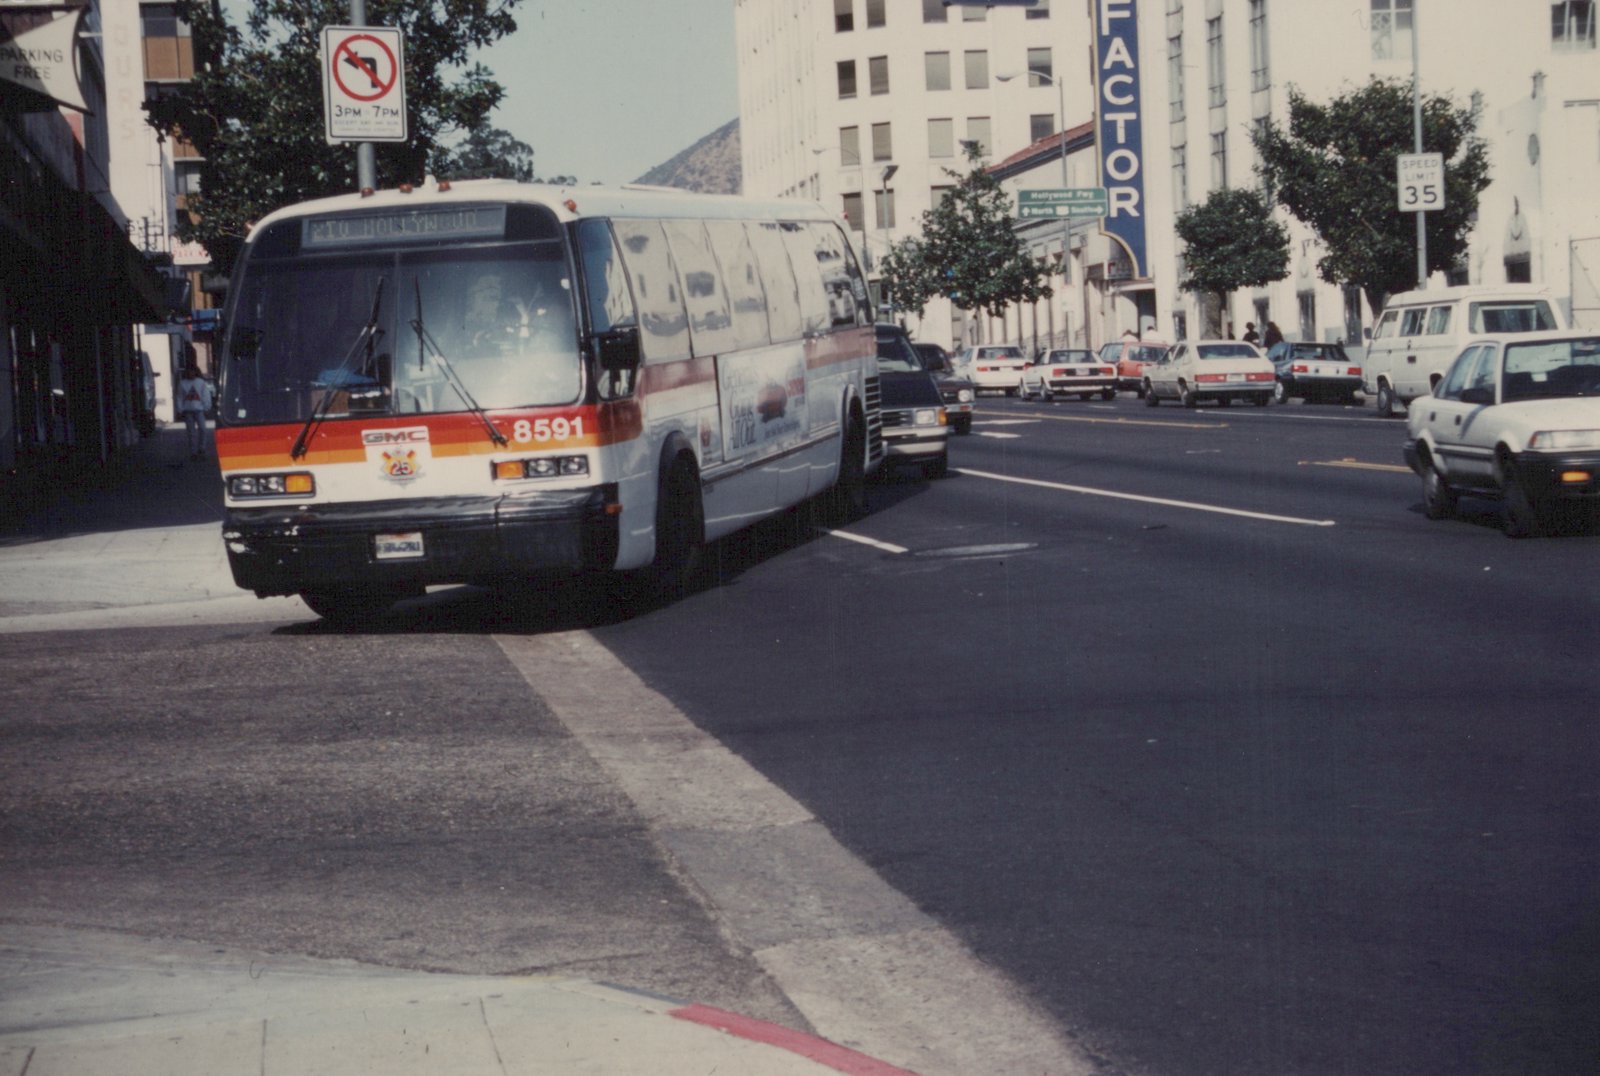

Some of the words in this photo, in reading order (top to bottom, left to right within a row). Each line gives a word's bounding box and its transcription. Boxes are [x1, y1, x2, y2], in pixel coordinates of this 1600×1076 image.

[14, 64, 51, 80] FREE
[335, 104, 361, 117] 3PM
[372, 105, 399, 117] 7PM
[1101, 0, 1140, 218] FACTOR
[1402, 159, 1438, 169] SPEED
[1405, 172, 1436, 181] LIMIT
[1030, 191, 1073, 200] Hollywood
[1076, 190, 1094, 199] Fwy
[1405, 184, 1437, 204] 35
[513, 416, 584, 443] 8591
[364, 430, 426, 443] GMC
